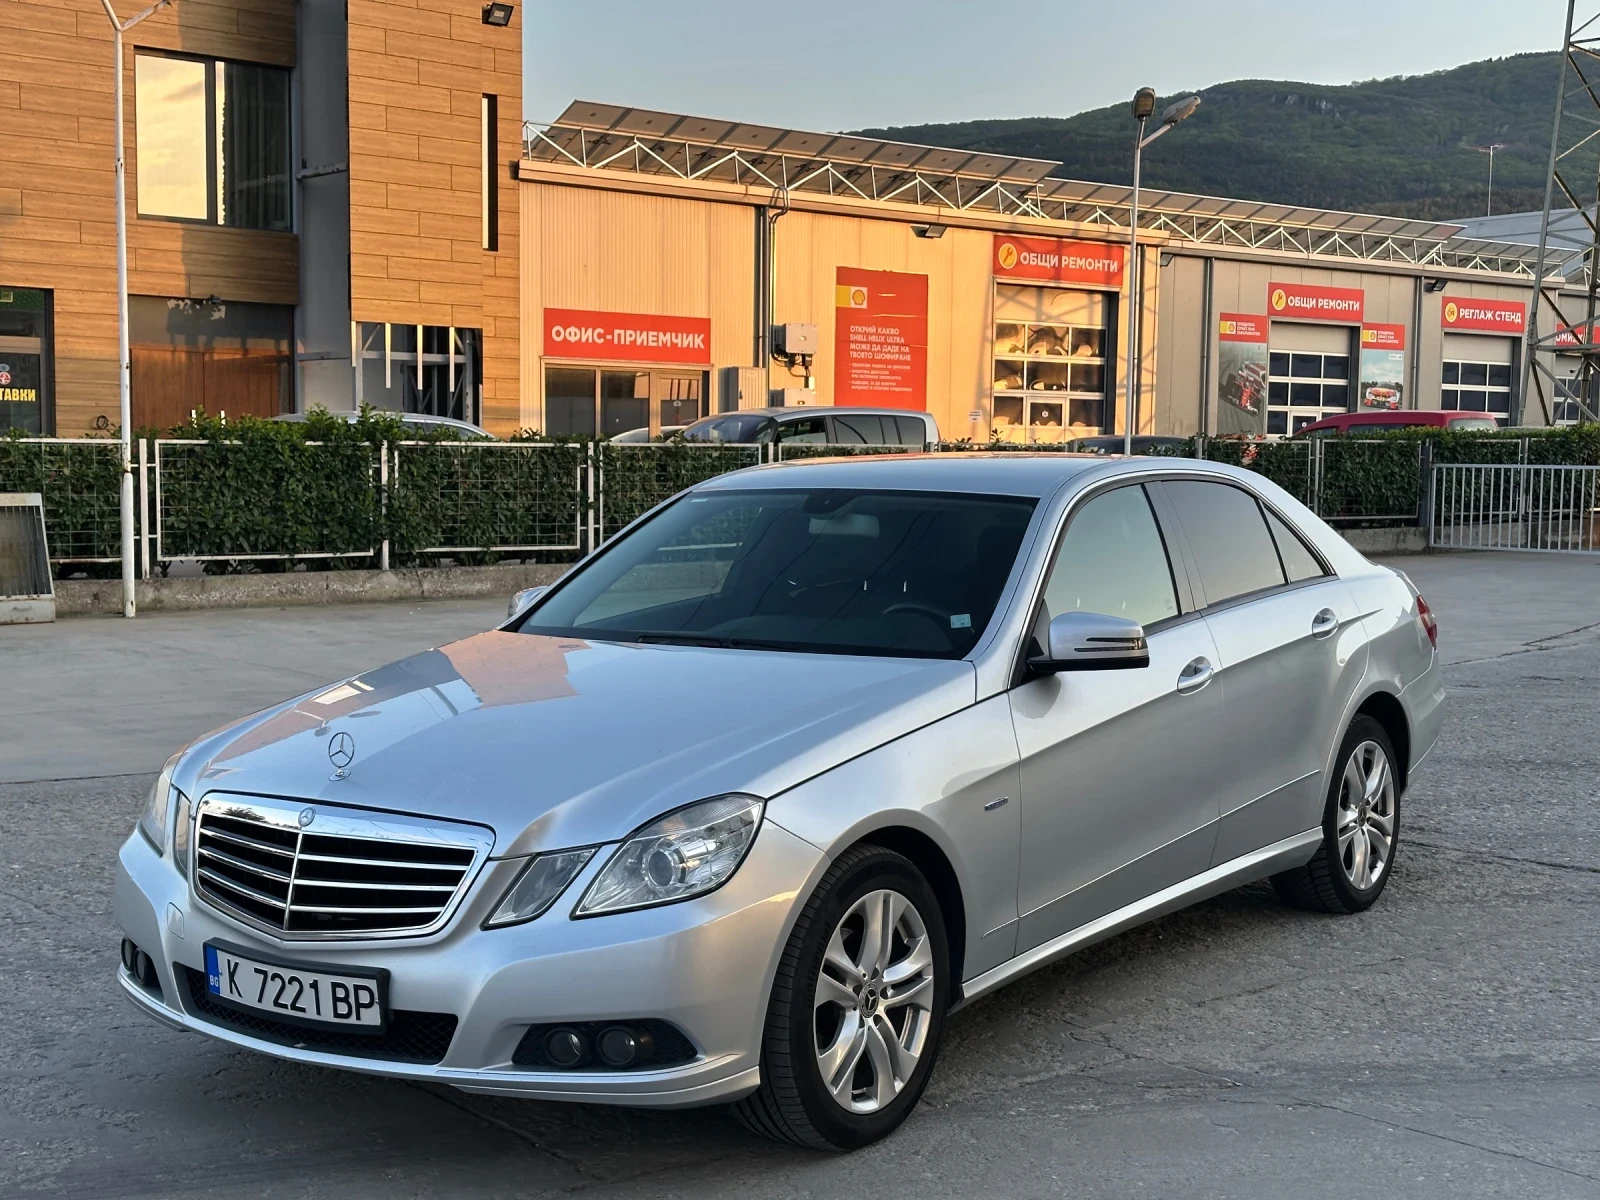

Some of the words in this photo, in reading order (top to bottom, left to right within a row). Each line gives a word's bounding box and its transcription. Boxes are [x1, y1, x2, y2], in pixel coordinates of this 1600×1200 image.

[1020, 251, 1059, 269] ОБЩИ
[1061, 255, 1118, 273] РЕМОНТИ
[1287, 295, 1316, 310] ОБЩИ
[1317, 298, 1360, 311] РЕМОНТИ
[1459, 308, 1494, 321] РЕГЛАЖ
[1495, 310, 1522, 325] СТЕНД
[551, 325, 705, 349] ОФИС-ПРИЕМЧИК
[850, 325, 876, 333] ОТКРИЙ
[877, 327, 899, 335] КАКВО
[850, 333, 867, 341] SHELL
[868, 335, 885, 343] HELIX
[886, 336, 905, 344] ULTRA
[850, 351, 873, 359] ТВОЕТО
[874, 353, 911, 361] ШОФИРАНЕ
[871, 344, 881, 352] ДА
[882, 345, 899, 353] ДАДЕ
[900, 345, 910, 353] НА
[209, 974, 220, 988] BG
[226, 958, 244, 998] K
[253, 967, 321, 1016] 7221
[330, 981, 375, 1021] BP
